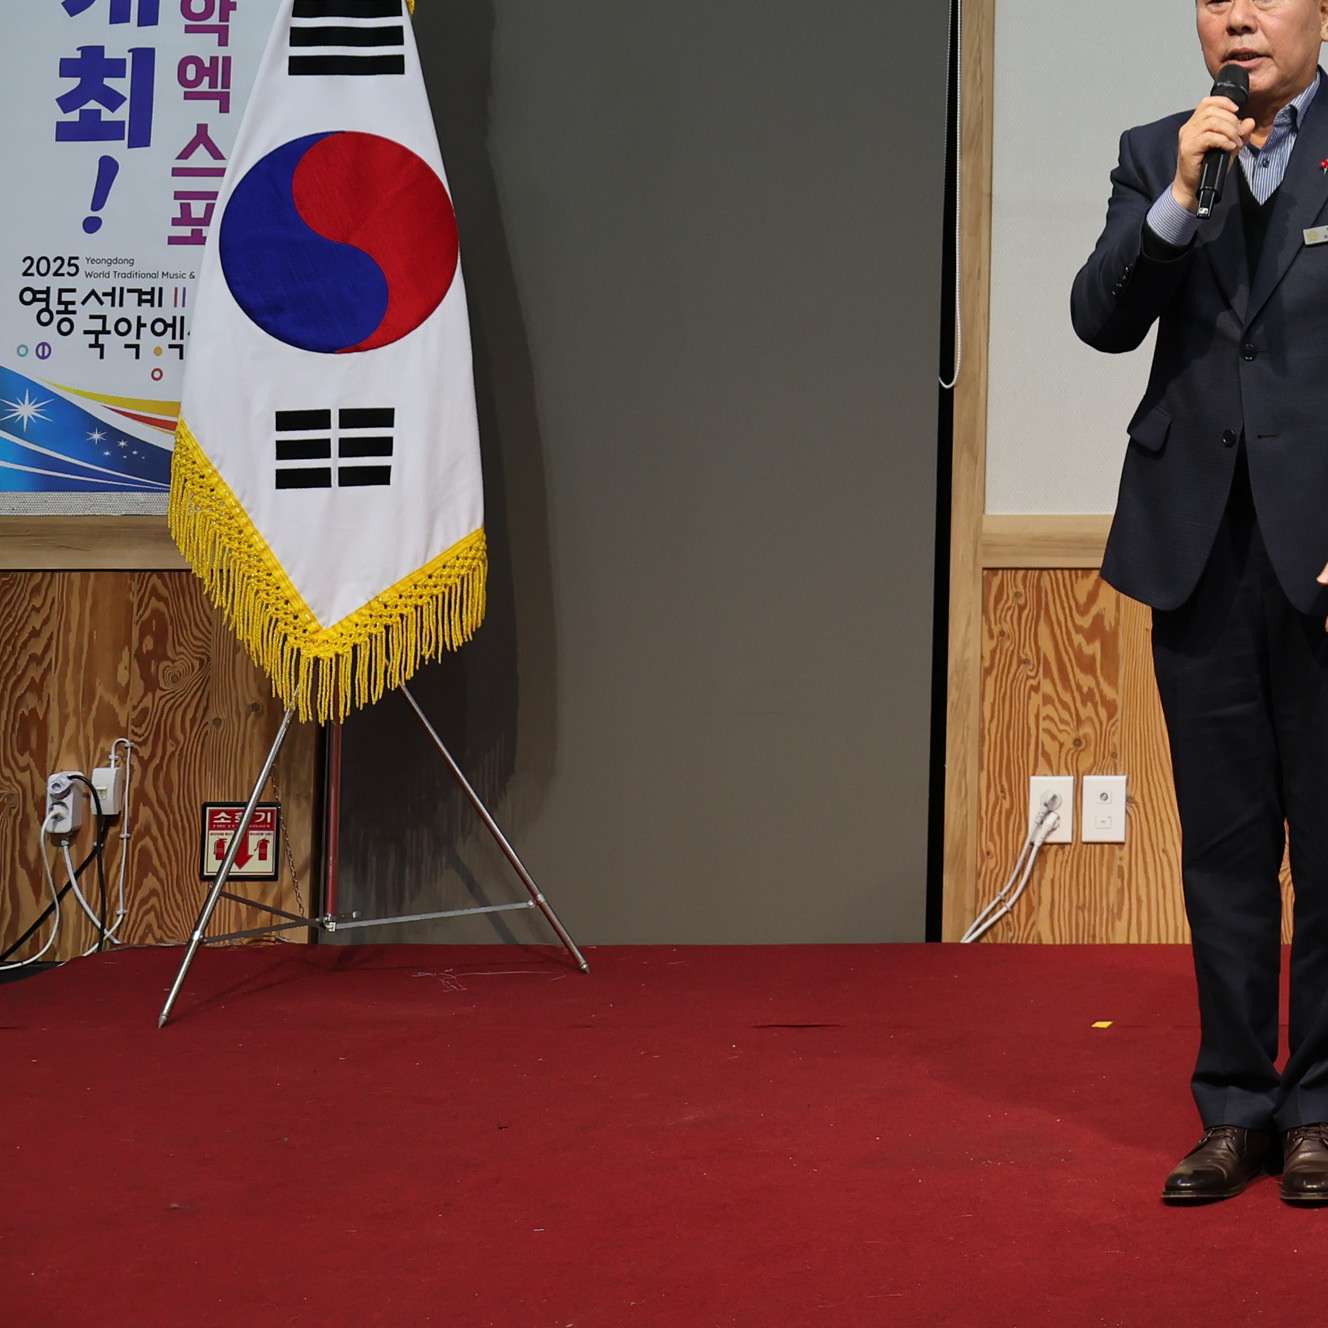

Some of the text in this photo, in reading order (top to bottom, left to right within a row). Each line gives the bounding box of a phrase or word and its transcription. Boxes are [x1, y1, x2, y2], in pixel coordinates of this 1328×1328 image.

[21, 255, 80, 277] 2025
[84, 256, 135, 267] Yeongdong
[84, 270, 196, 280] World Traditional Music &
[18, 285, 164, 337] 영동세계
[83, 314, 192, 360] 국악엑
